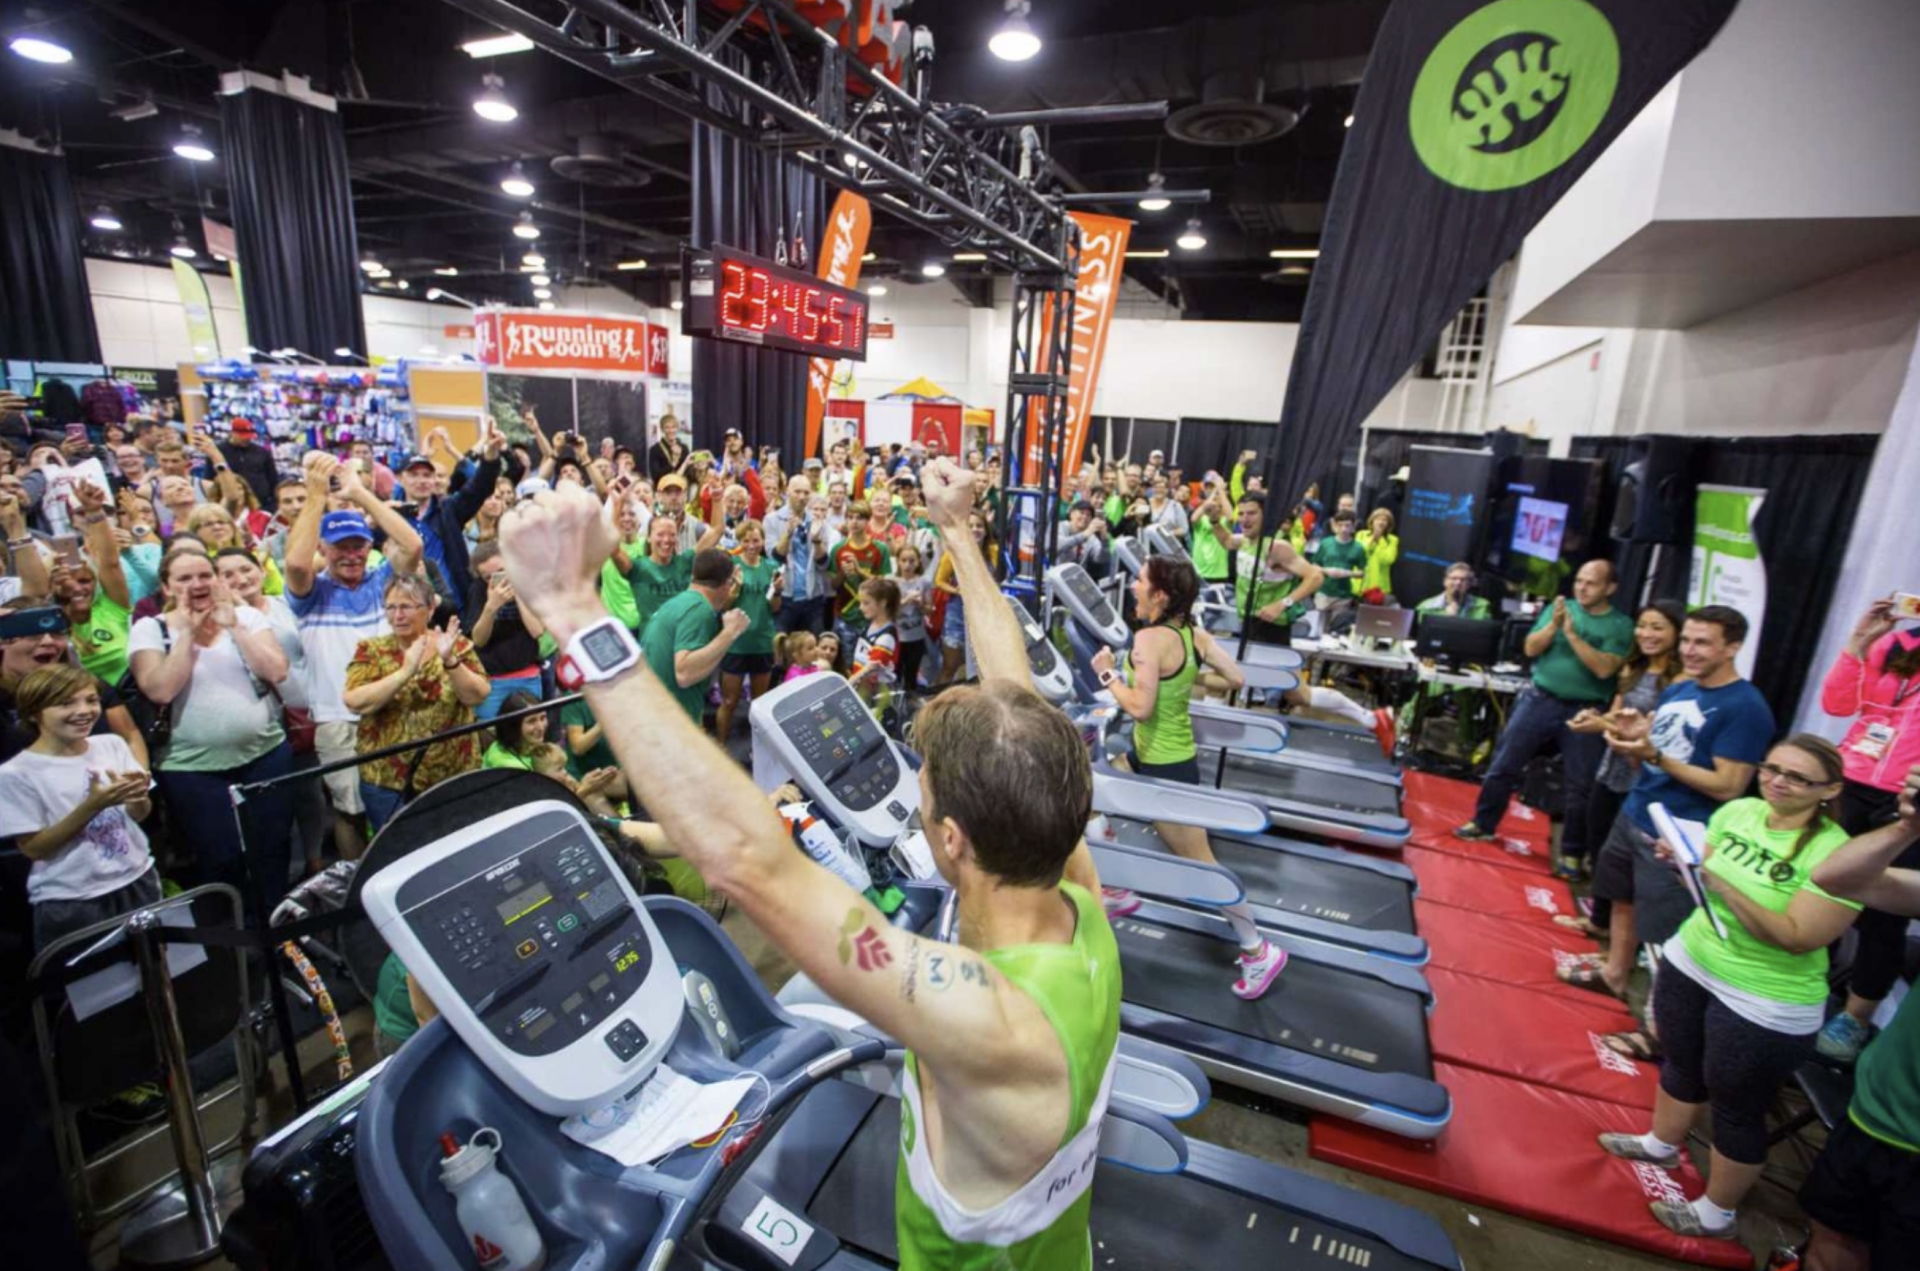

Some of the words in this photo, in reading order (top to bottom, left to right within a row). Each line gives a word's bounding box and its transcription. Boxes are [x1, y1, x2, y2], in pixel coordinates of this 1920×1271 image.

[521, 324, 623, 352] Running
[1046, 1169, 1077, 1204] for
[756, 1211, 799, 1246] 5
